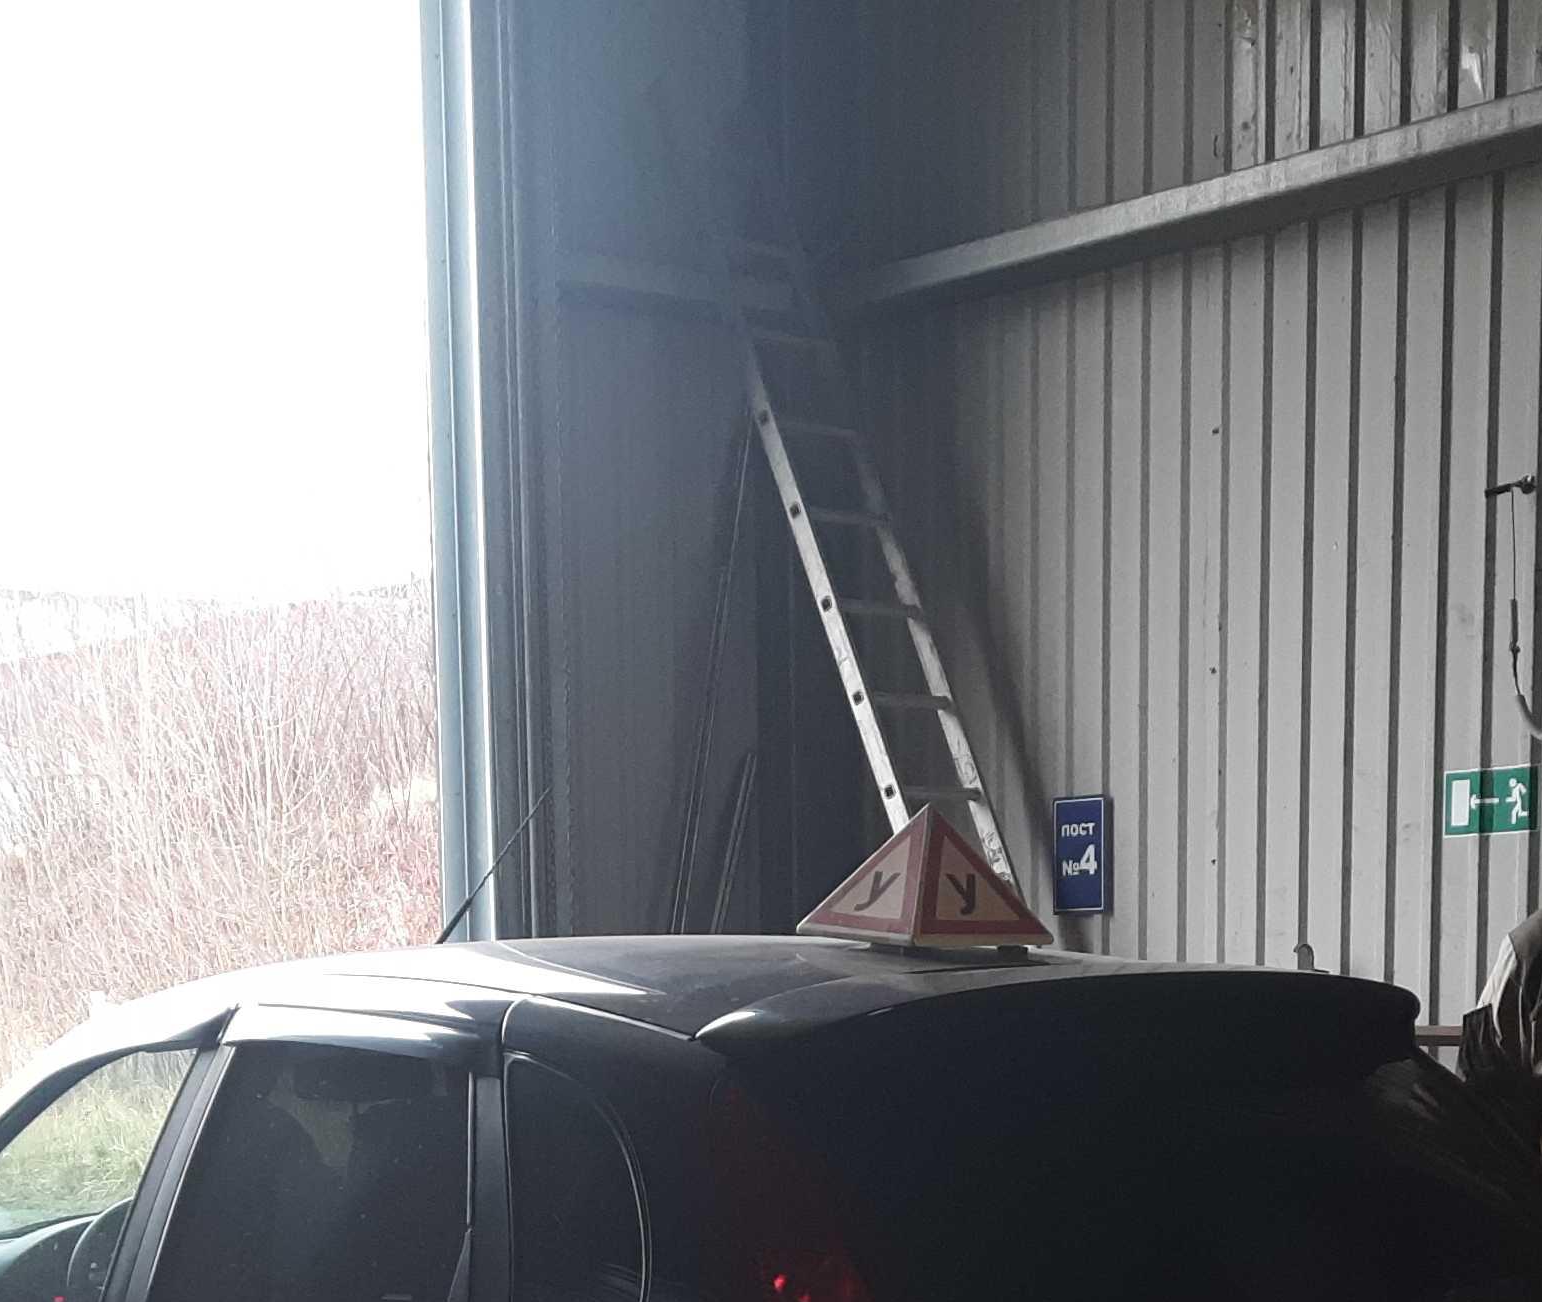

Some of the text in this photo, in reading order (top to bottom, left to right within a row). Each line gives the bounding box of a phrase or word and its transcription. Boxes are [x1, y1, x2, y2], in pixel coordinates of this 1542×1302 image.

[1062, 844, 1098, 877] №4
[854, 870, 901, 911] У
[945, 873, 977, 915] У
